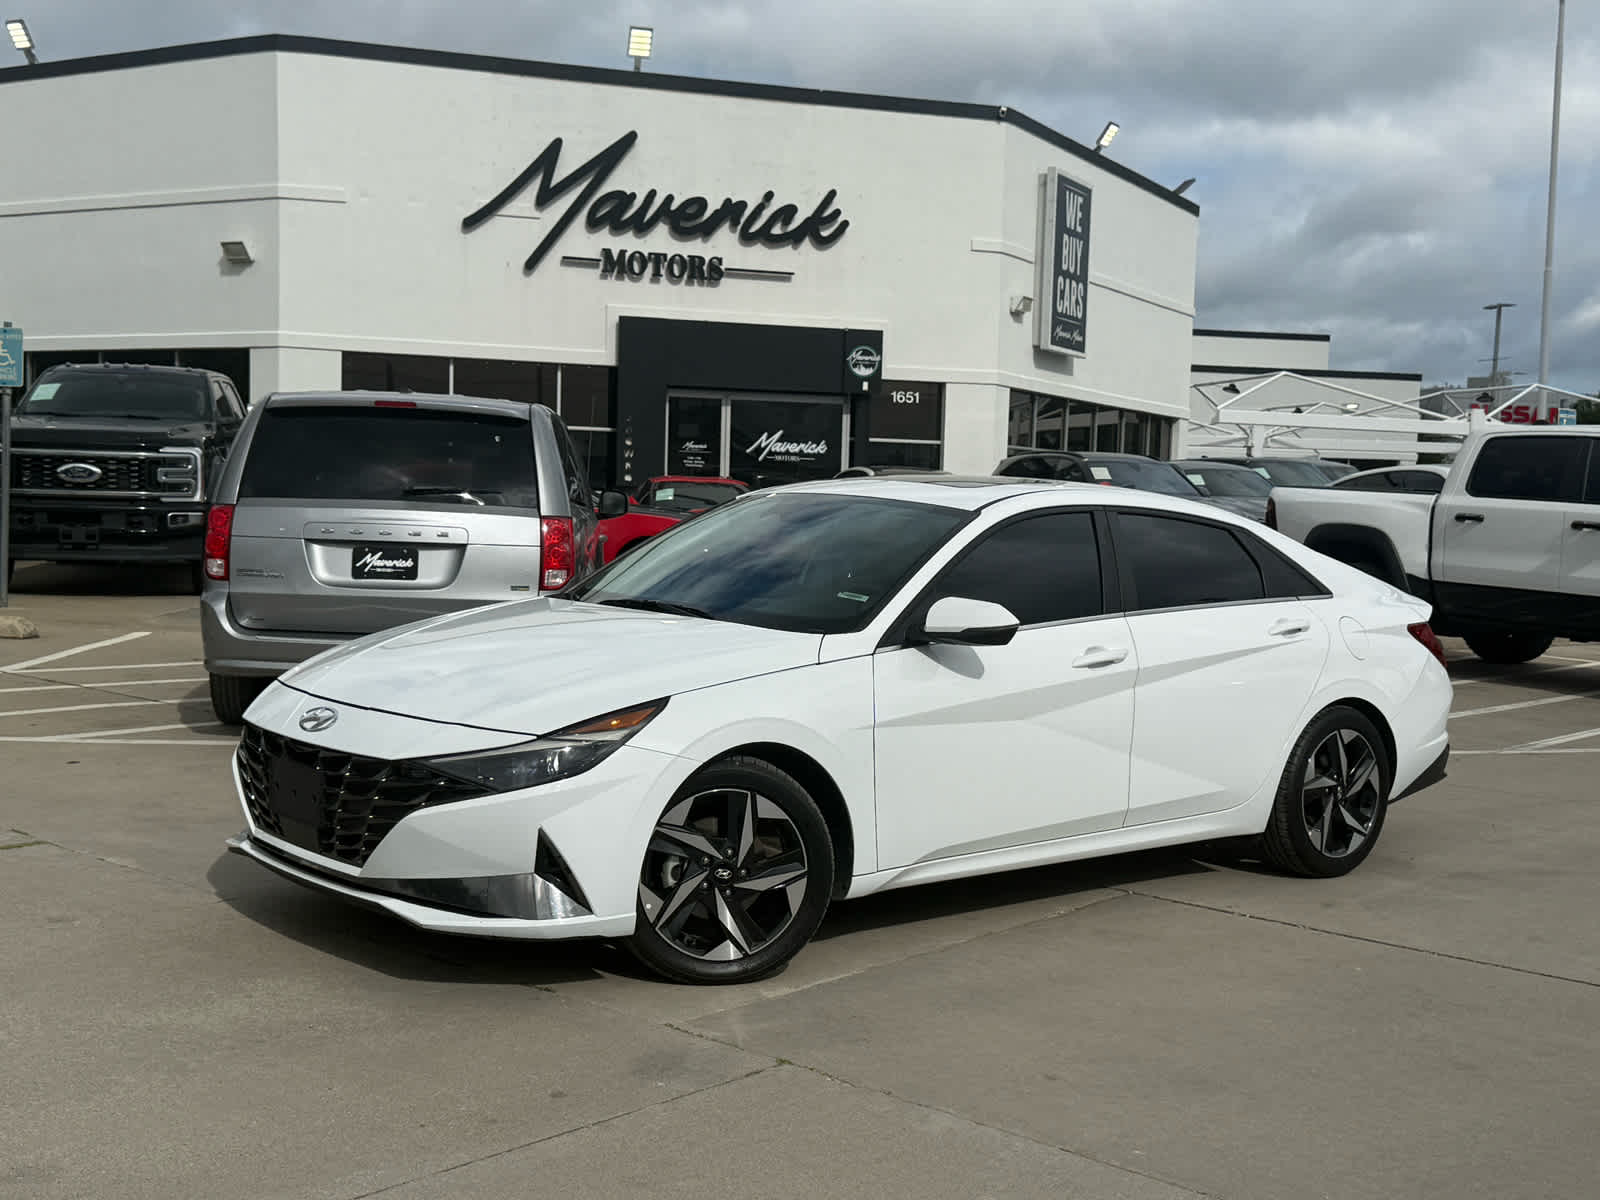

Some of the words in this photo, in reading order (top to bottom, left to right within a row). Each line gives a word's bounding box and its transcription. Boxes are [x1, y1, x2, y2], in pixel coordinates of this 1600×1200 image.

[462, 130, 849, 272] Maverick
[1065, 190, 1084, 233] WE
[601, 248, 725, 282] MOTORS
[1061, 233, 1084, 276] BUY
[1056, 275, 1084, 319] CARS
[891, 391, 920, 404] 1651
[745, 429, 828, 462] Maverick
[355, 551, 414, 572] Maverick
